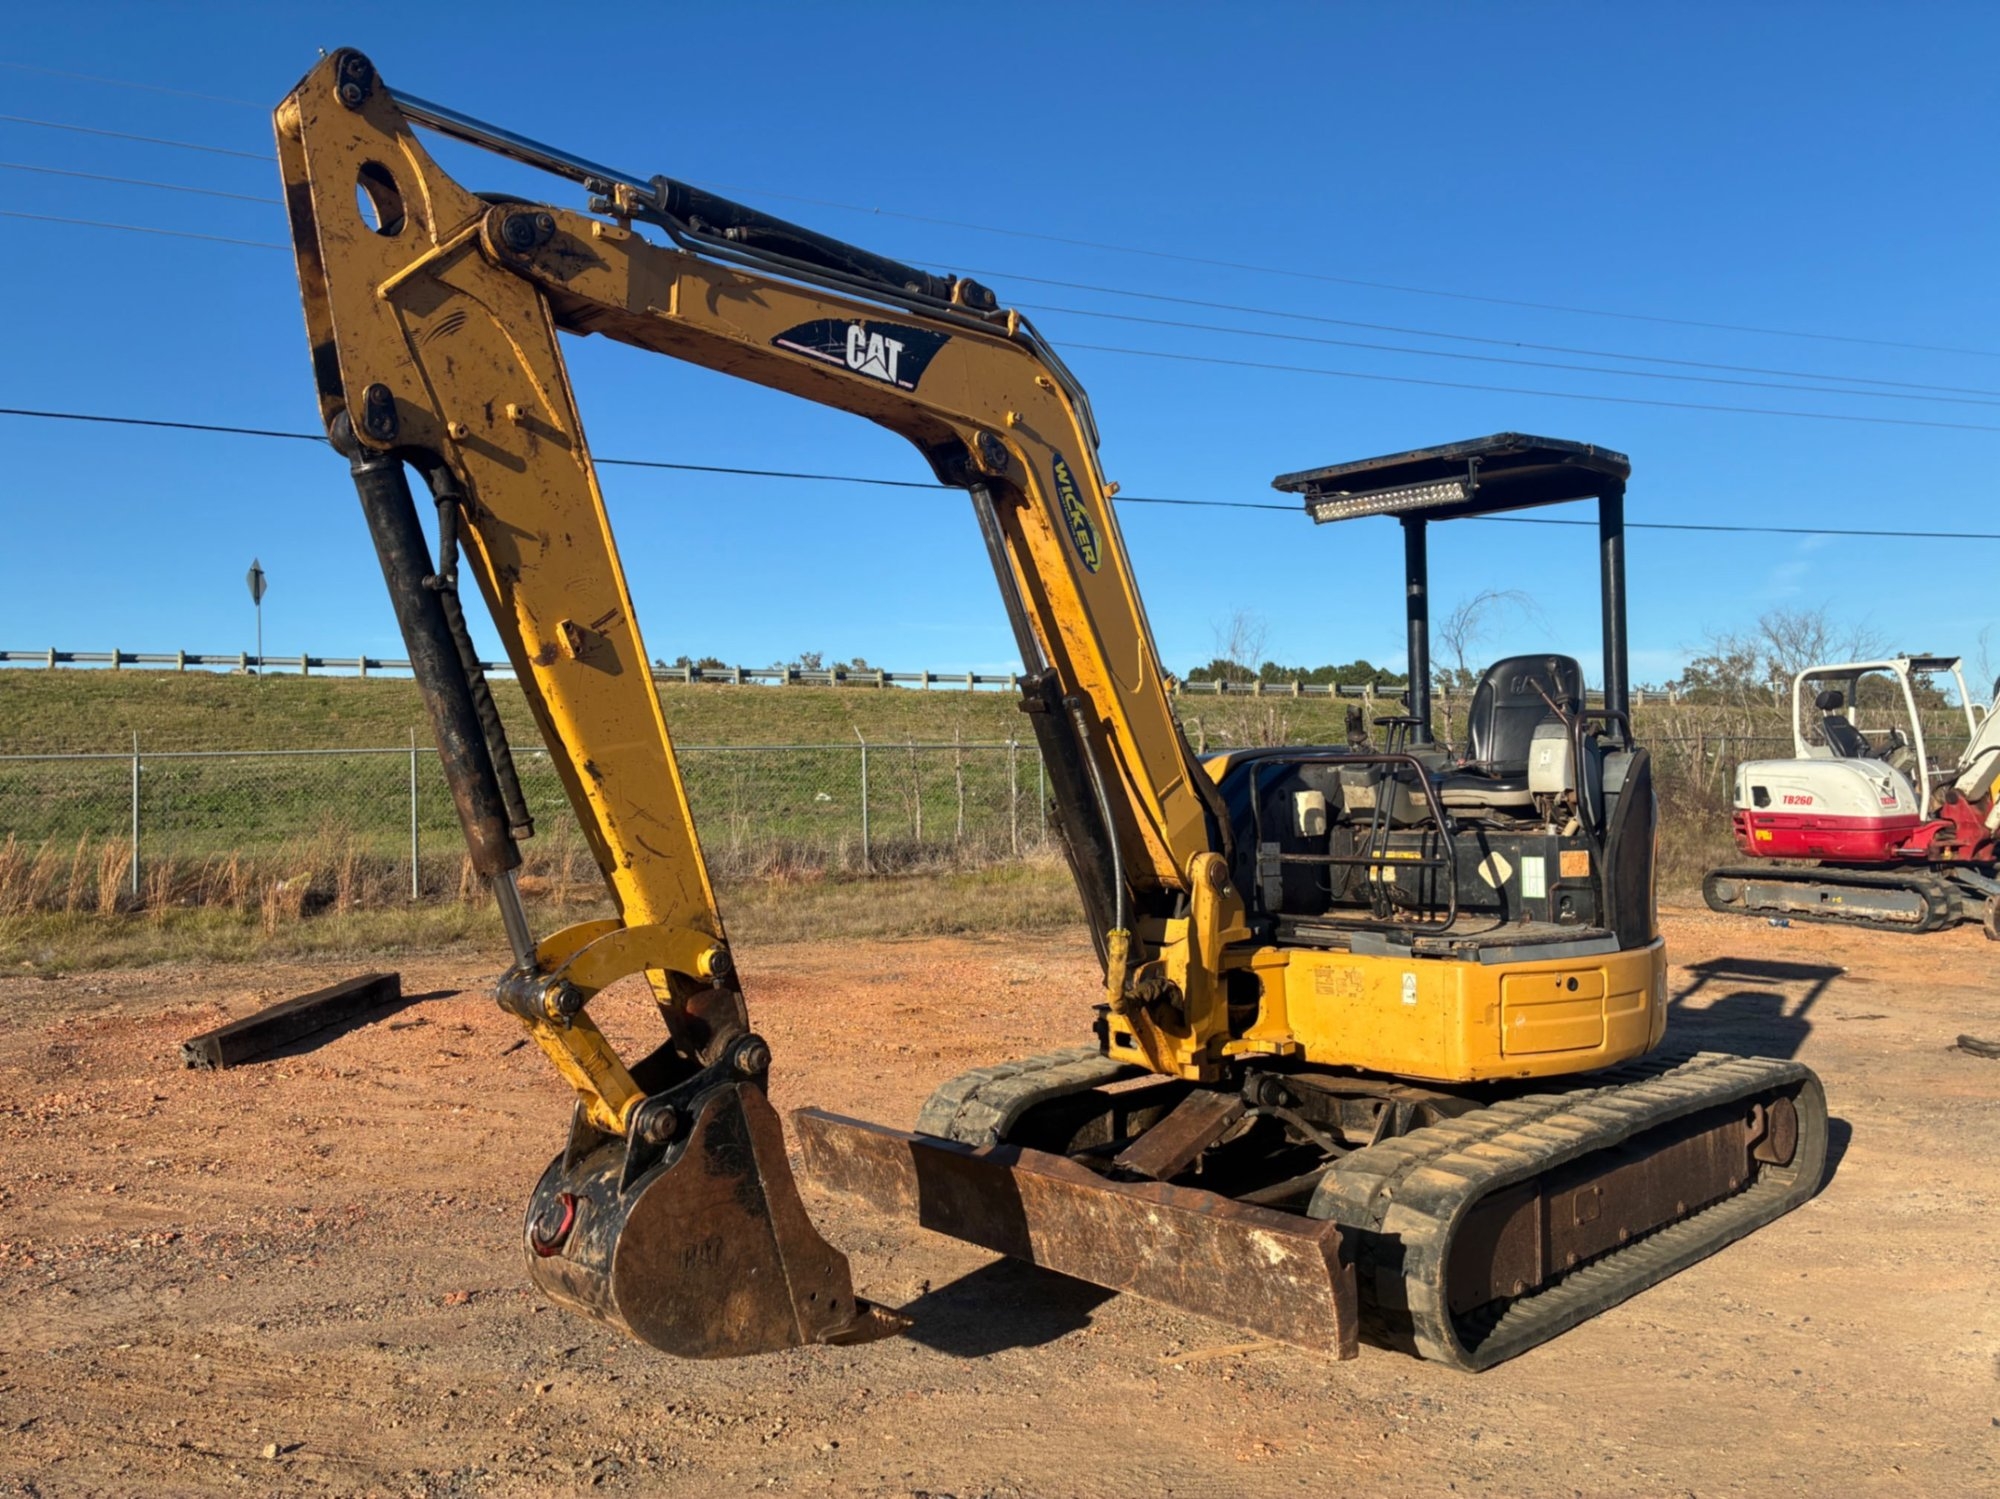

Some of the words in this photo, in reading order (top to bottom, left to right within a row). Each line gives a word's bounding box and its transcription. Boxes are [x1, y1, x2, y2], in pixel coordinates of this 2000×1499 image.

[846, 324, 904, 383] CAT
[1054, 461, 1098, 565] WICKER
[1783, 795, 1813, 805] TB260
